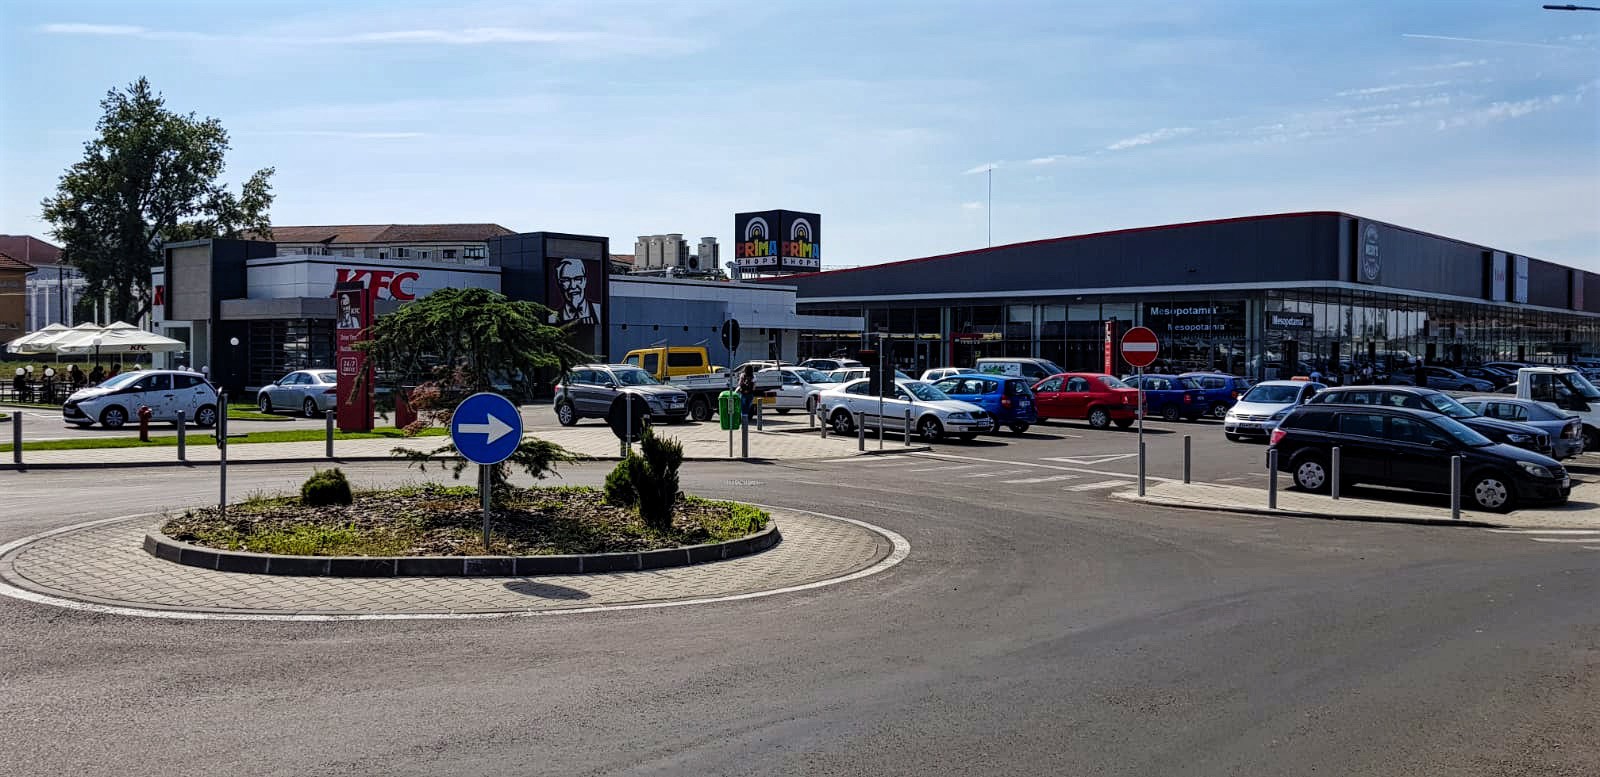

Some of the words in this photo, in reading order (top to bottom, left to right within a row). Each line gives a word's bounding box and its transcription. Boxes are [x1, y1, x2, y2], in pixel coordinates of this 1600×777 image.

[736, 240, 777, 257] PRIMA
[782, 240, 819, 258] PRIMA
[783, 258, 819, 266] SHOPS
[330, 269, 420, 300] KFC
